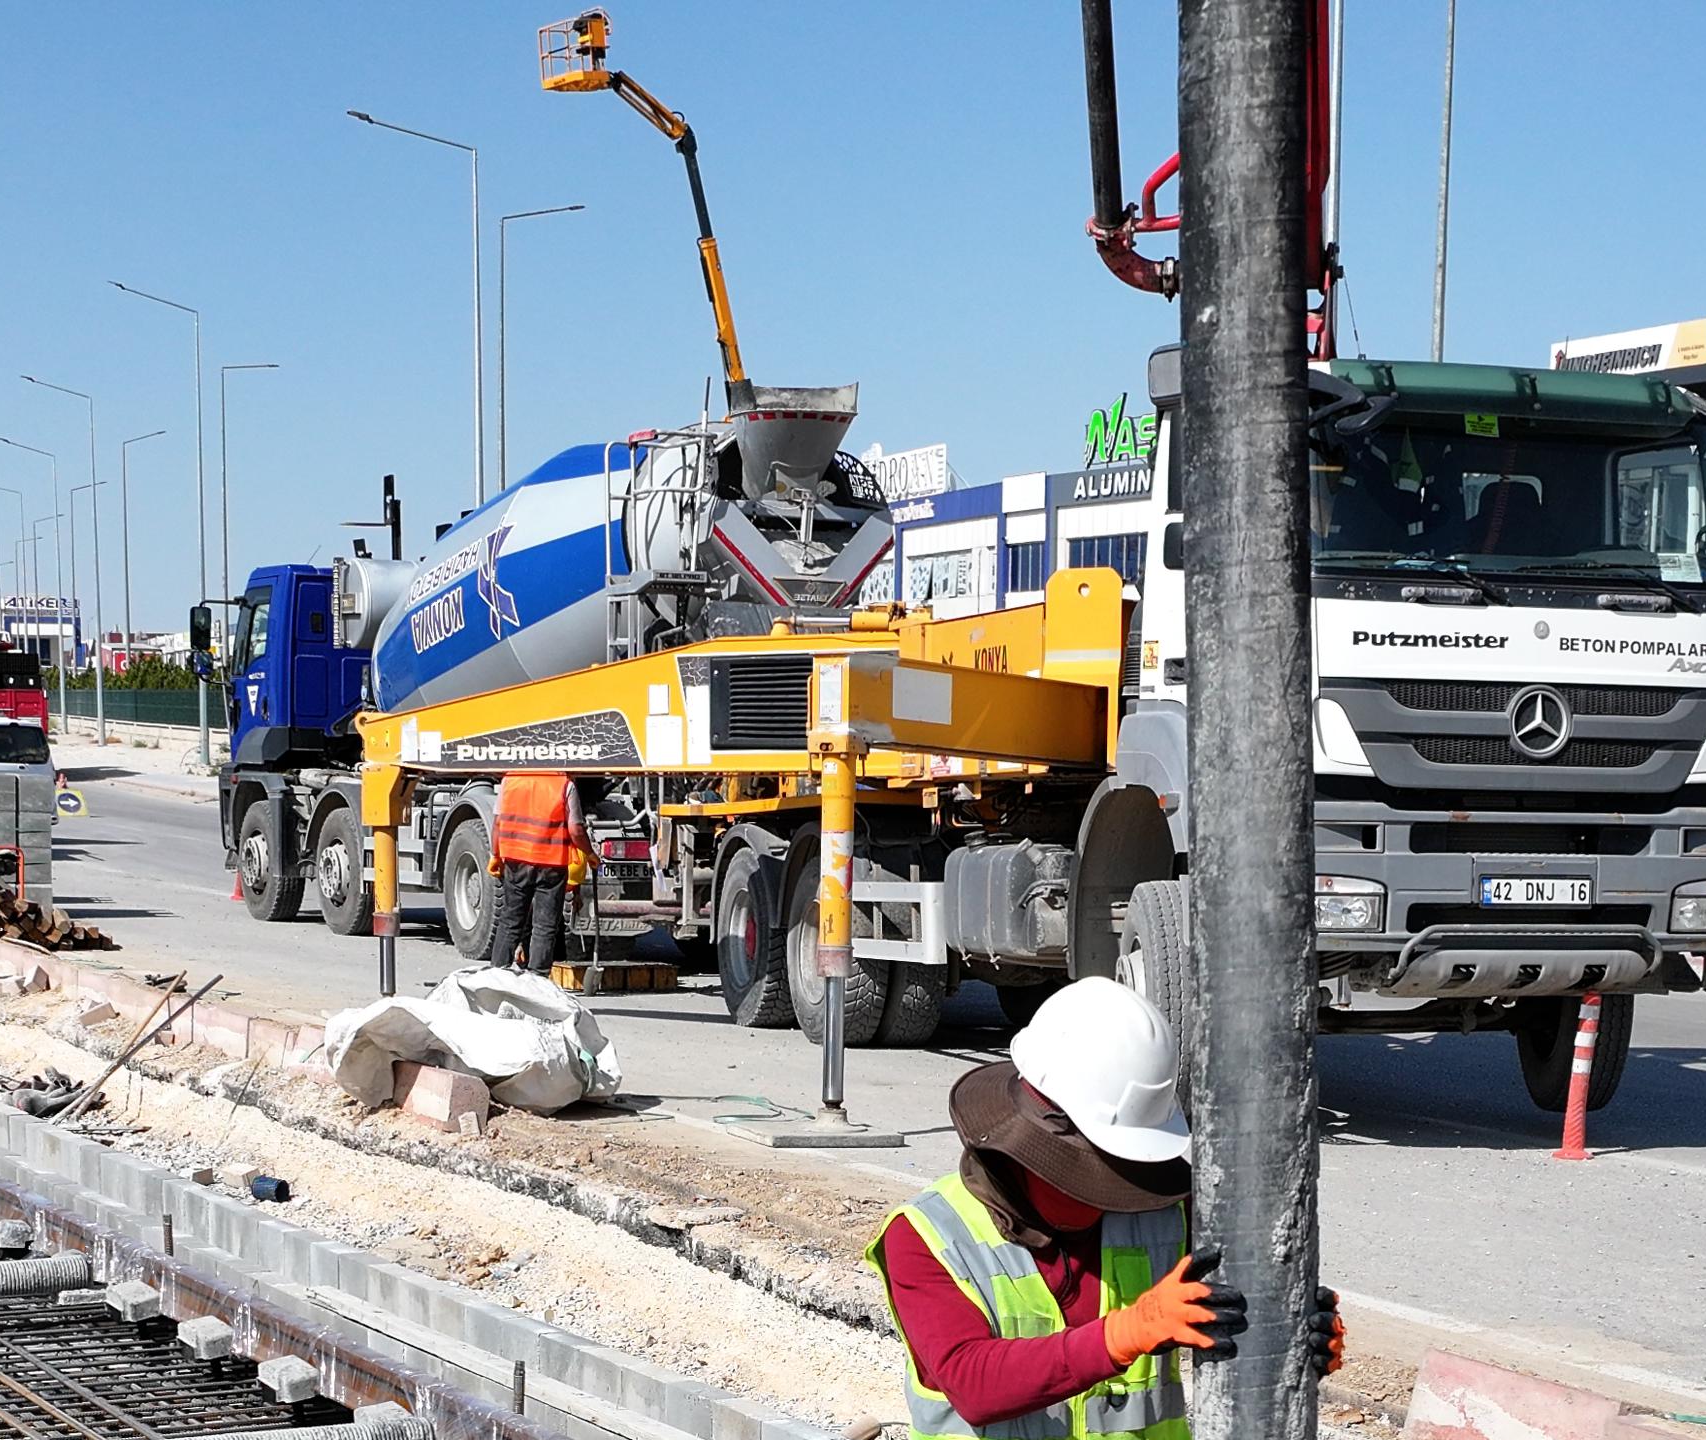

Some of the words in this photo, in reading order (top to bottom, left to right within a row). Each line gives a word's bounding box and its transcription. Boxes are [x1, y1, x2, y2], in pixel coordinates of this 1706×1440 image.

[411, 585, 465, 655] KONYA
[1352, 630, 1509, 649] Putzmeister
[1559, 637, 1616, 654] BETON
[457, 742, 602, 761] Putzmeister
[620, 864, 639, 877] EBE
[1493, 882, 1512, 901] 42
[1525, 882, 1555, 901] DNJ
[1570, 882, 1587, 902] 16
